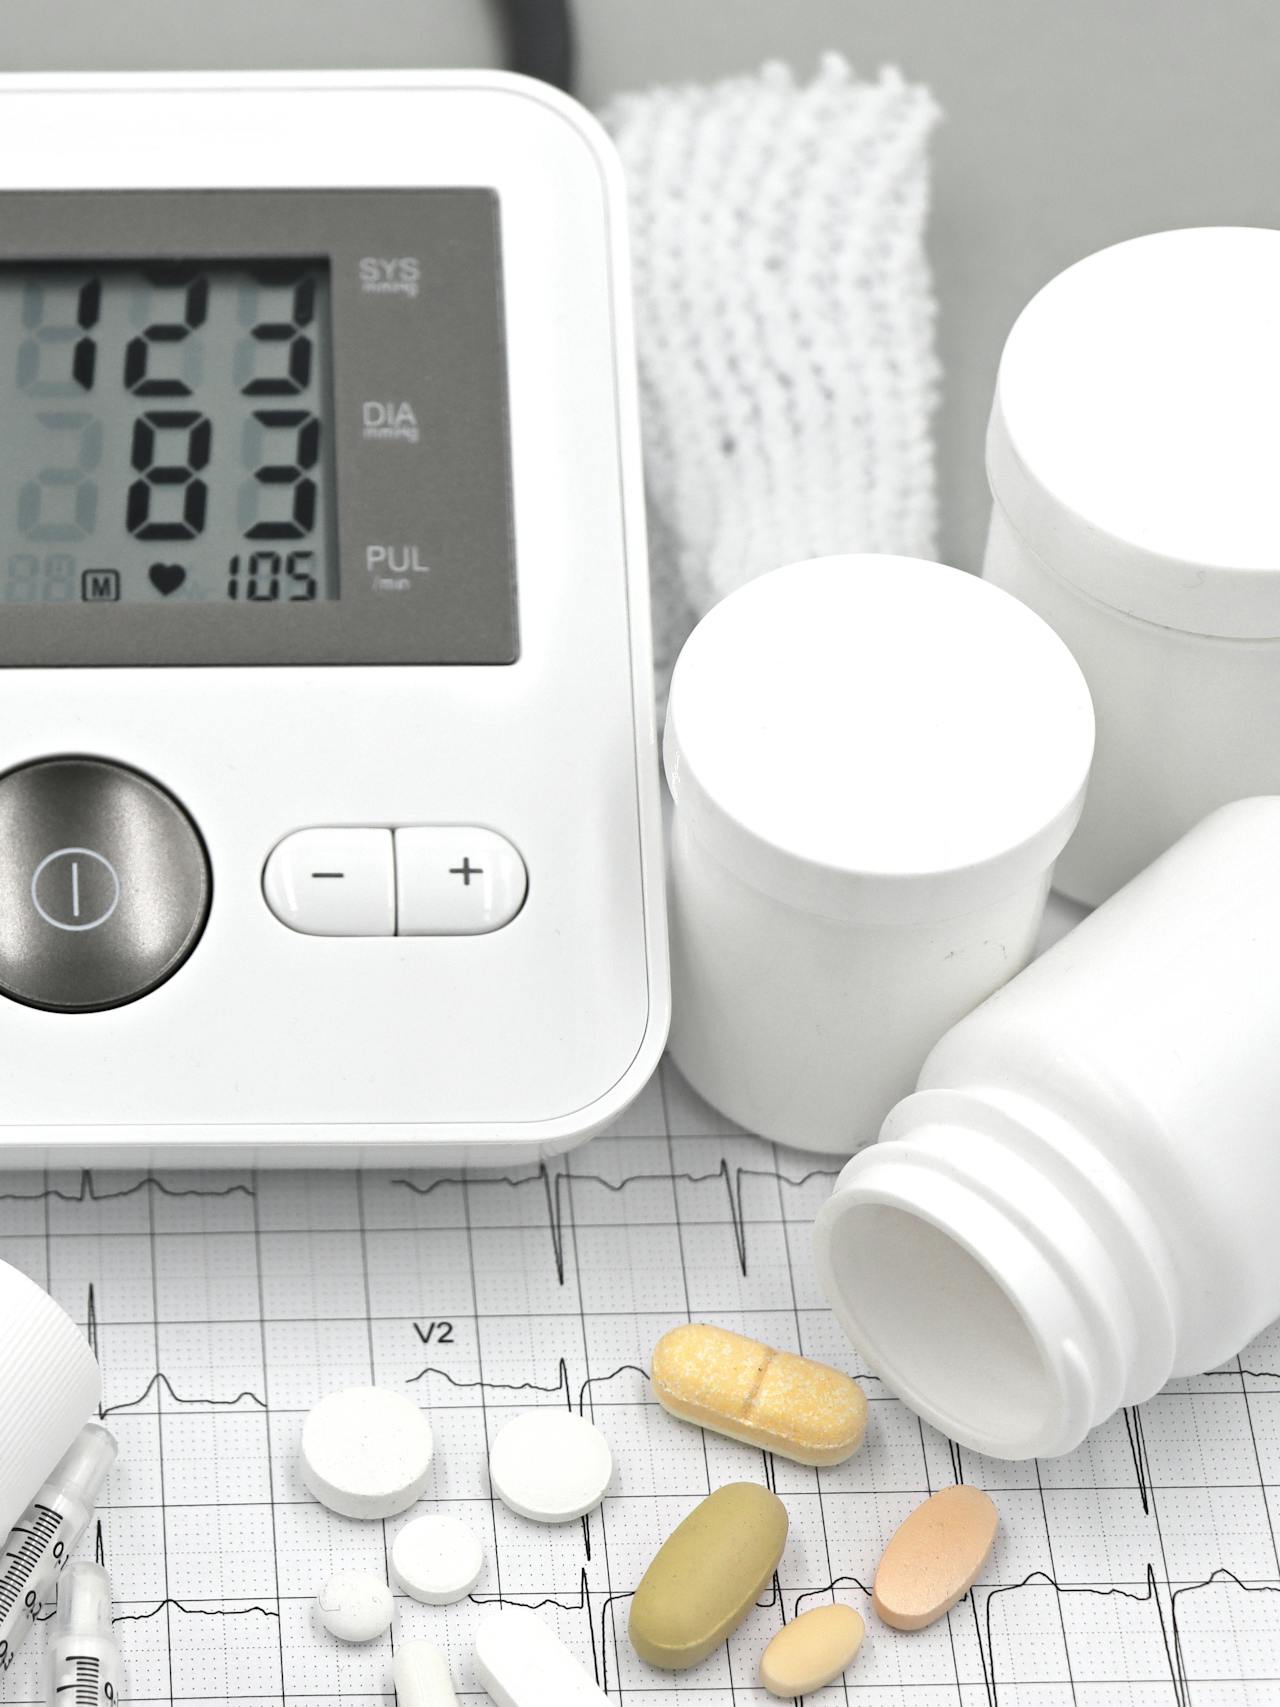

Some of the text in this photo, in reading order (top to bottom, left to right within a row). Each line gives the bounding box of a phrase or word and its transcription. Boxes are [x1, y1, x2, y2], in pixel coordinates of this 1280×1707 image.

[359, 257, 420, 281] SYS
[73, 269, 316, 397] 123
[362, 401, 417, 426] DIA
[126, 410, 320, 541] 83
[365, 545, 430, 572] PUL
[228, 551, 317, 600] 105
[412, 1321, 455, 1344] V2
